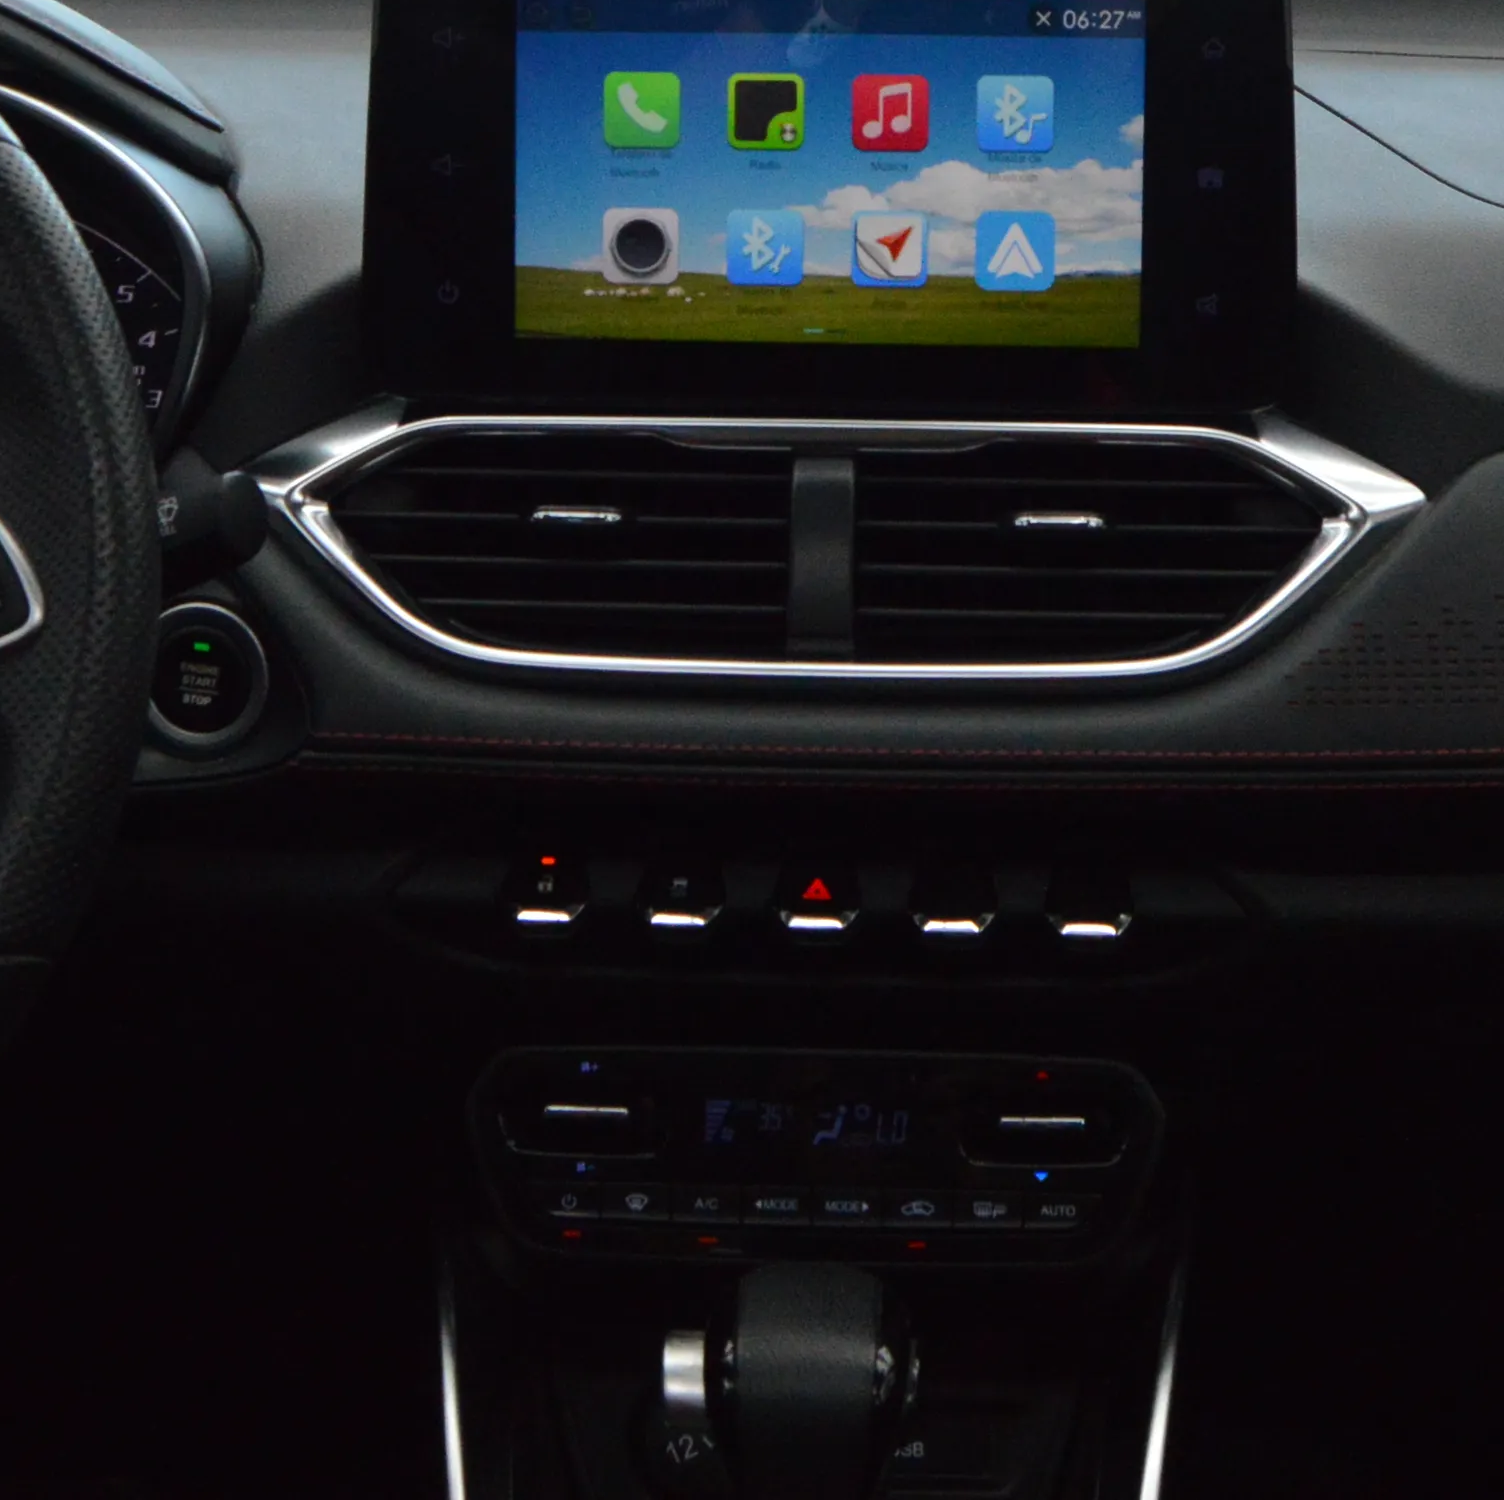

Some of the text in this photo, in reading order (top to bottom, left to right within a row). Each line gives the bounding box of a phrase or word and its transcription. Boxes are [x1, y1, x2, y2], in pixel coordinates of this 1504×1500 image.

[1062, 9, 1125, 30] 06:27
[116, 285, 136, 304] 5
[137, 330, 158, 349] 4
[145, 389, 164, 409] 3
[181, 693, 213, 706] STOP
[694, 1197, 720, 1211] A/C
[761, 1197, 799, 1211] MODE
[824, 1200, 859, 1213] MODE
[1040, 1204, 1076, 1217] AUTO
